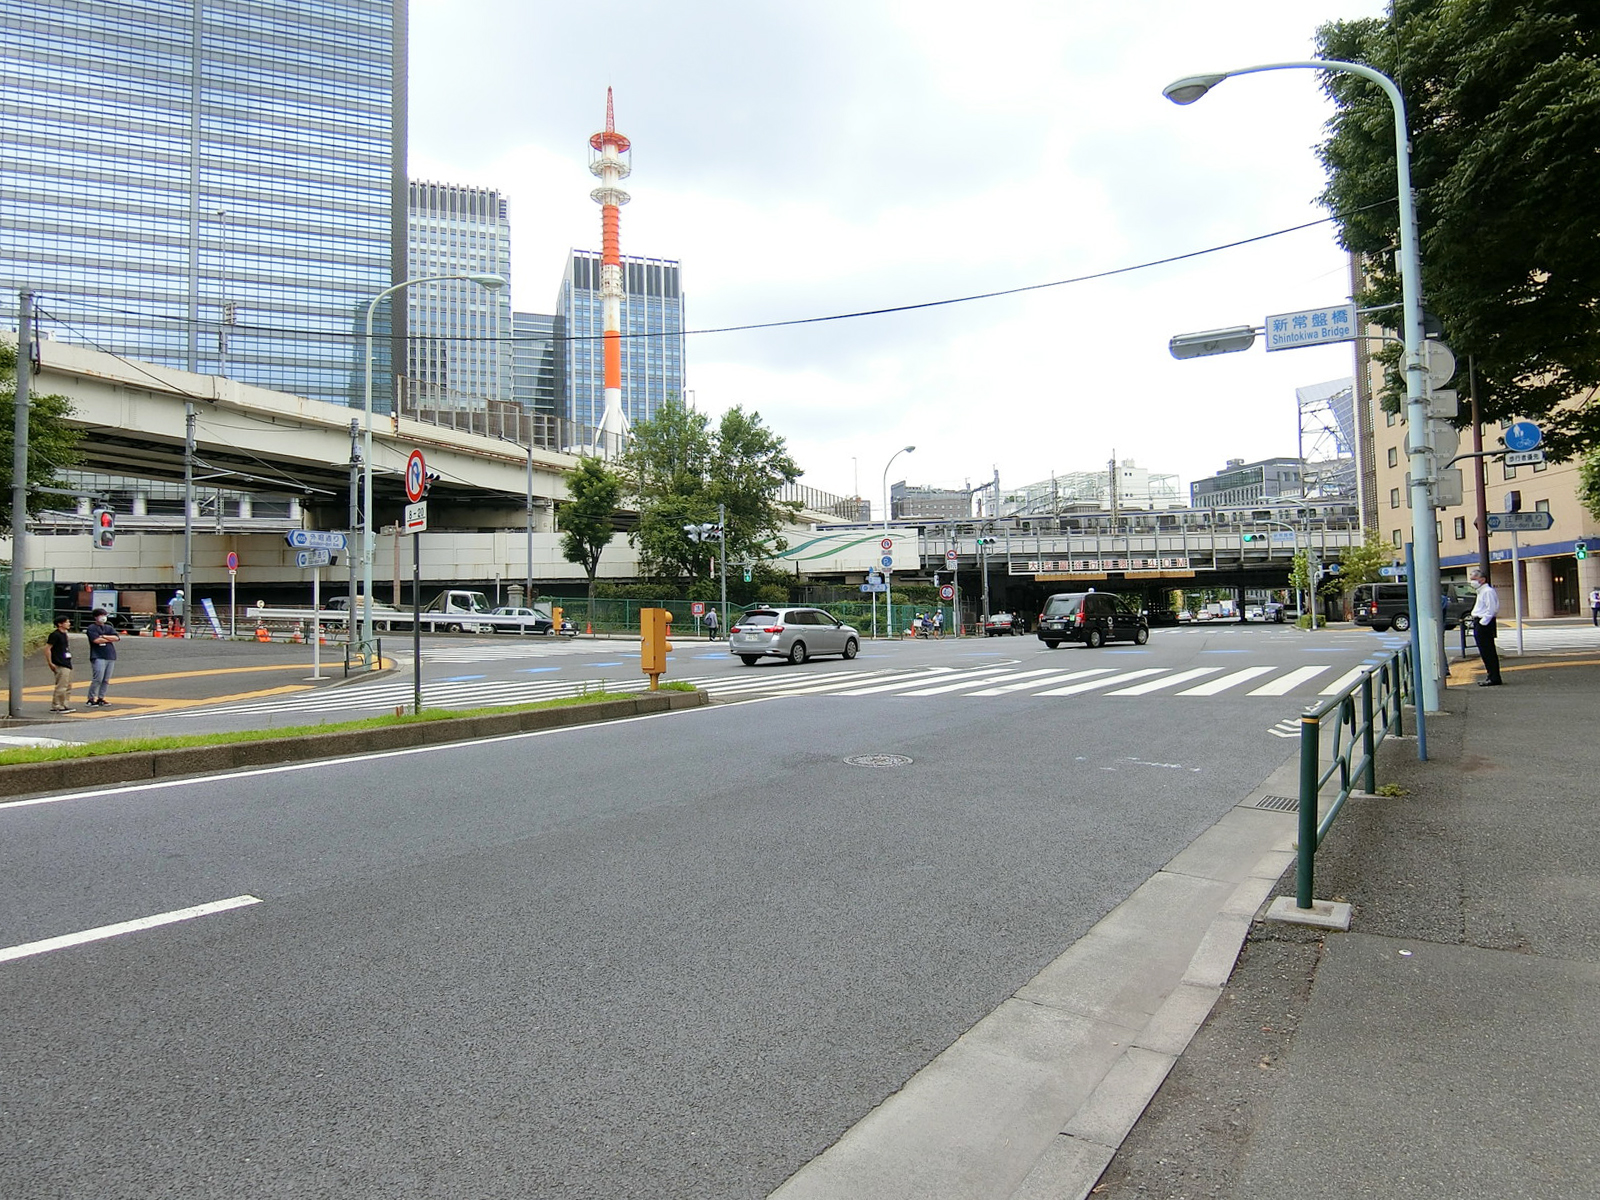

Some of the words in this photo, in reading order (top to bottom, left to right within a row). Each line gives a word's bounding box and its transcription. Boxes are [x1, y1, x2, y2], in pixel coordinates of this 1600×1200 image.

[1273, 310, 1348, 332] 新常盤橋
[1272, 331, 1318, 344] Shintokiwa
[1321, 326, 1350, 338] Bridge
[408, 507, 425, 520] 8-20
[1505, 514, 1543, 522] 江戸通り
